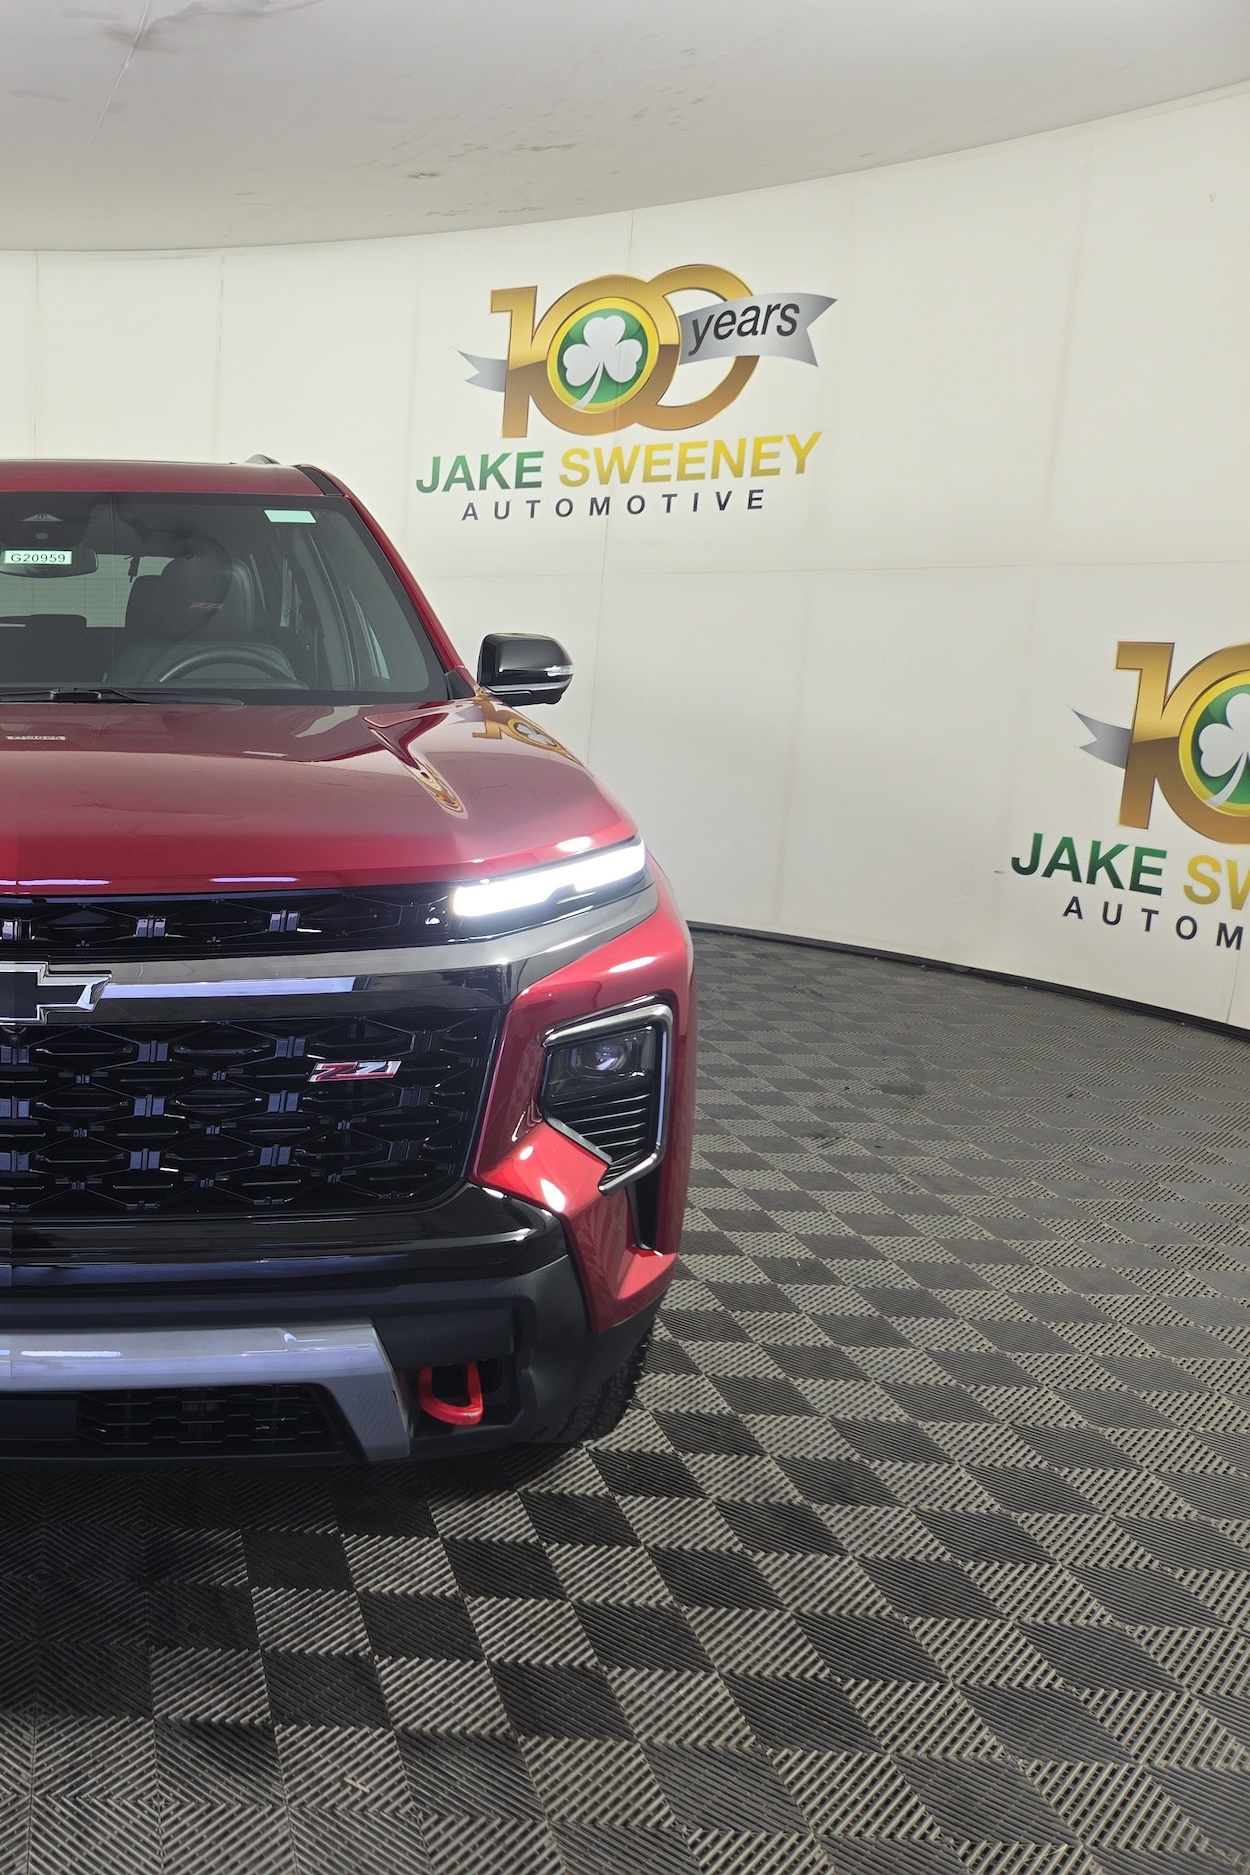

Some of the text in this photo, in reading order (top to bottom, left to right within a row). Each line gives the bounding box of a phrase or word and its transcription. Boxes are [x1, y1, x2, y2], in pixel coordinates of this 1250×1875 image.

[687, 301, 801, 357] years
[416, 431, 823, 493] JAKE SWEENEY
[461, 488, 765, 522] AUTOMOTIVE
[10, 553, 66, 563] G20959
[1011, 833, 1167, 896] JAKE
